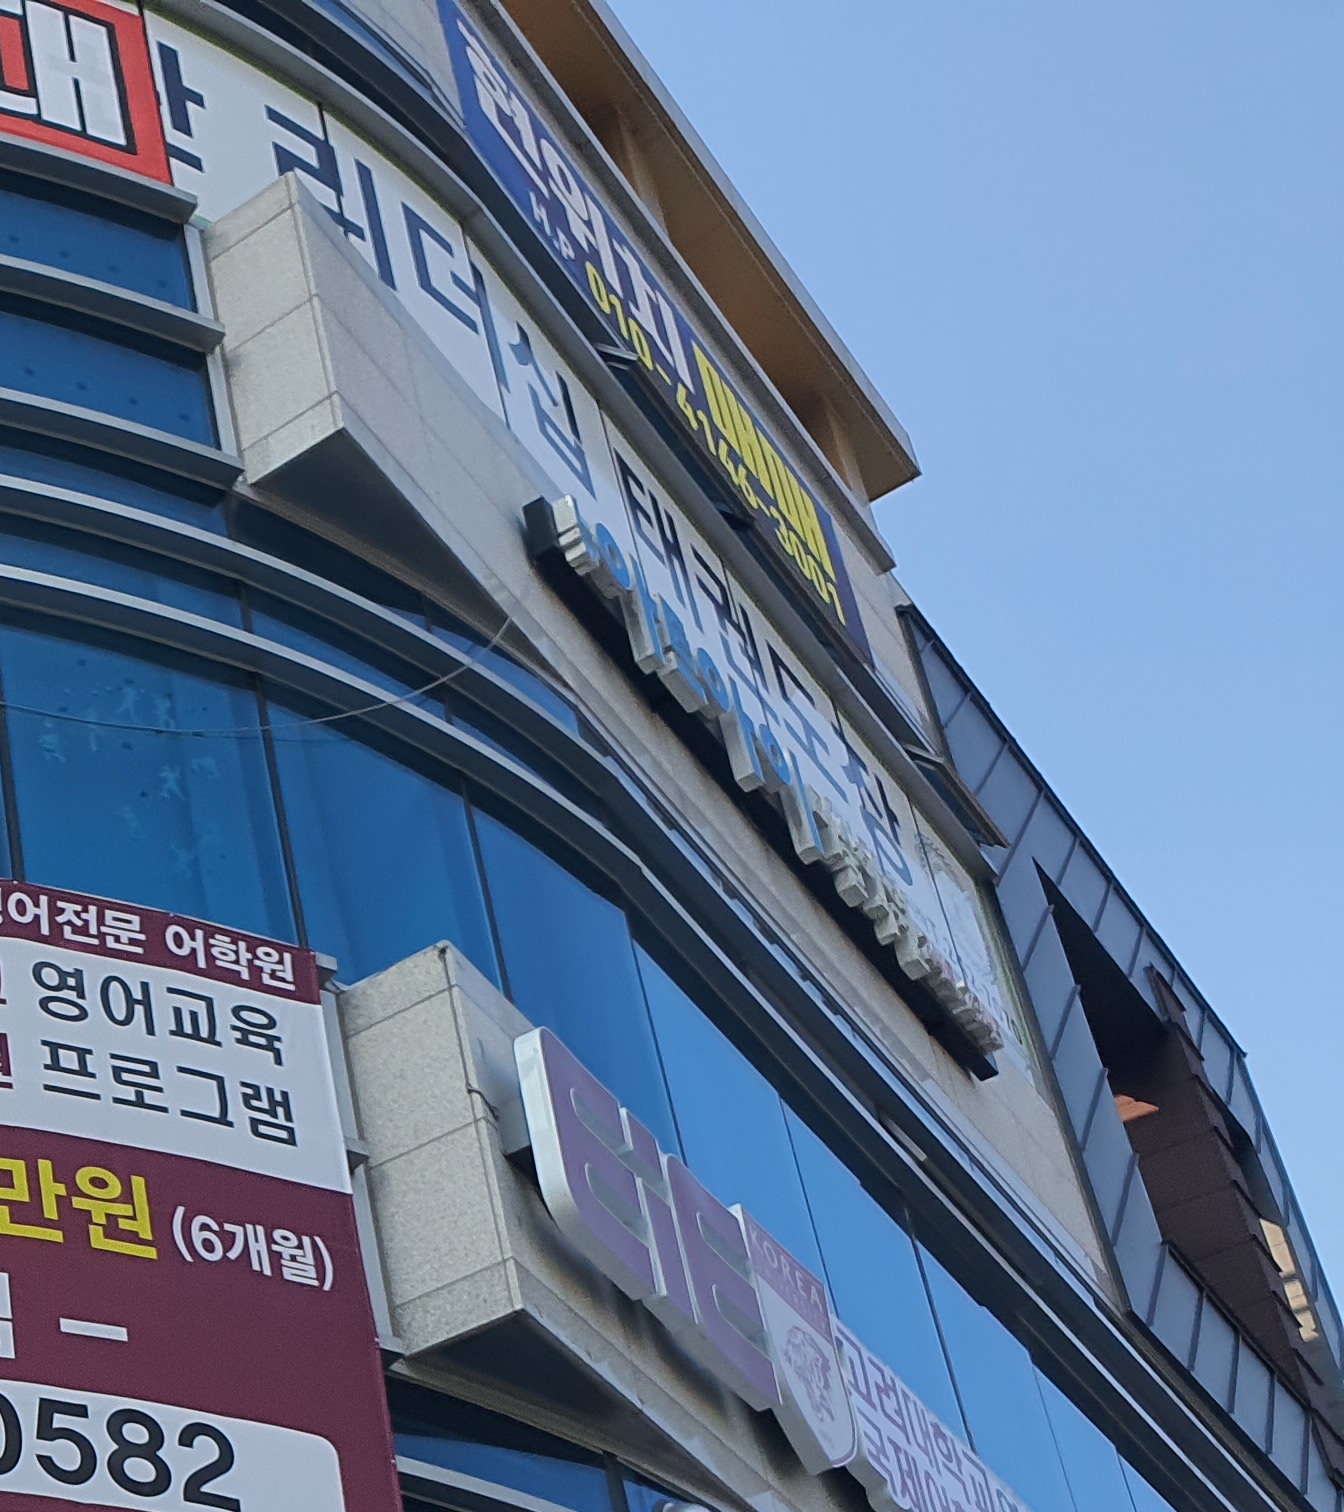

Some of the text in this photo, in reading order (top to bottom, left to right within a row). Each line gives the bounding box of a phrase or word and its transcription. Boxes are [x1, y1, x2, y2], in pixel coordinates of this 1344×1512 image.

[457, 19, 836, 577] 현위치 매매
[613, 446, 914, 886] 태권도장
[164, 924, 296, 991] 어학원
[32, 960, 285, 1067] 영어교육
[40, 1039, 298, 1147] 프로그램
[172, 1204, 334, 1292] (6개월)
